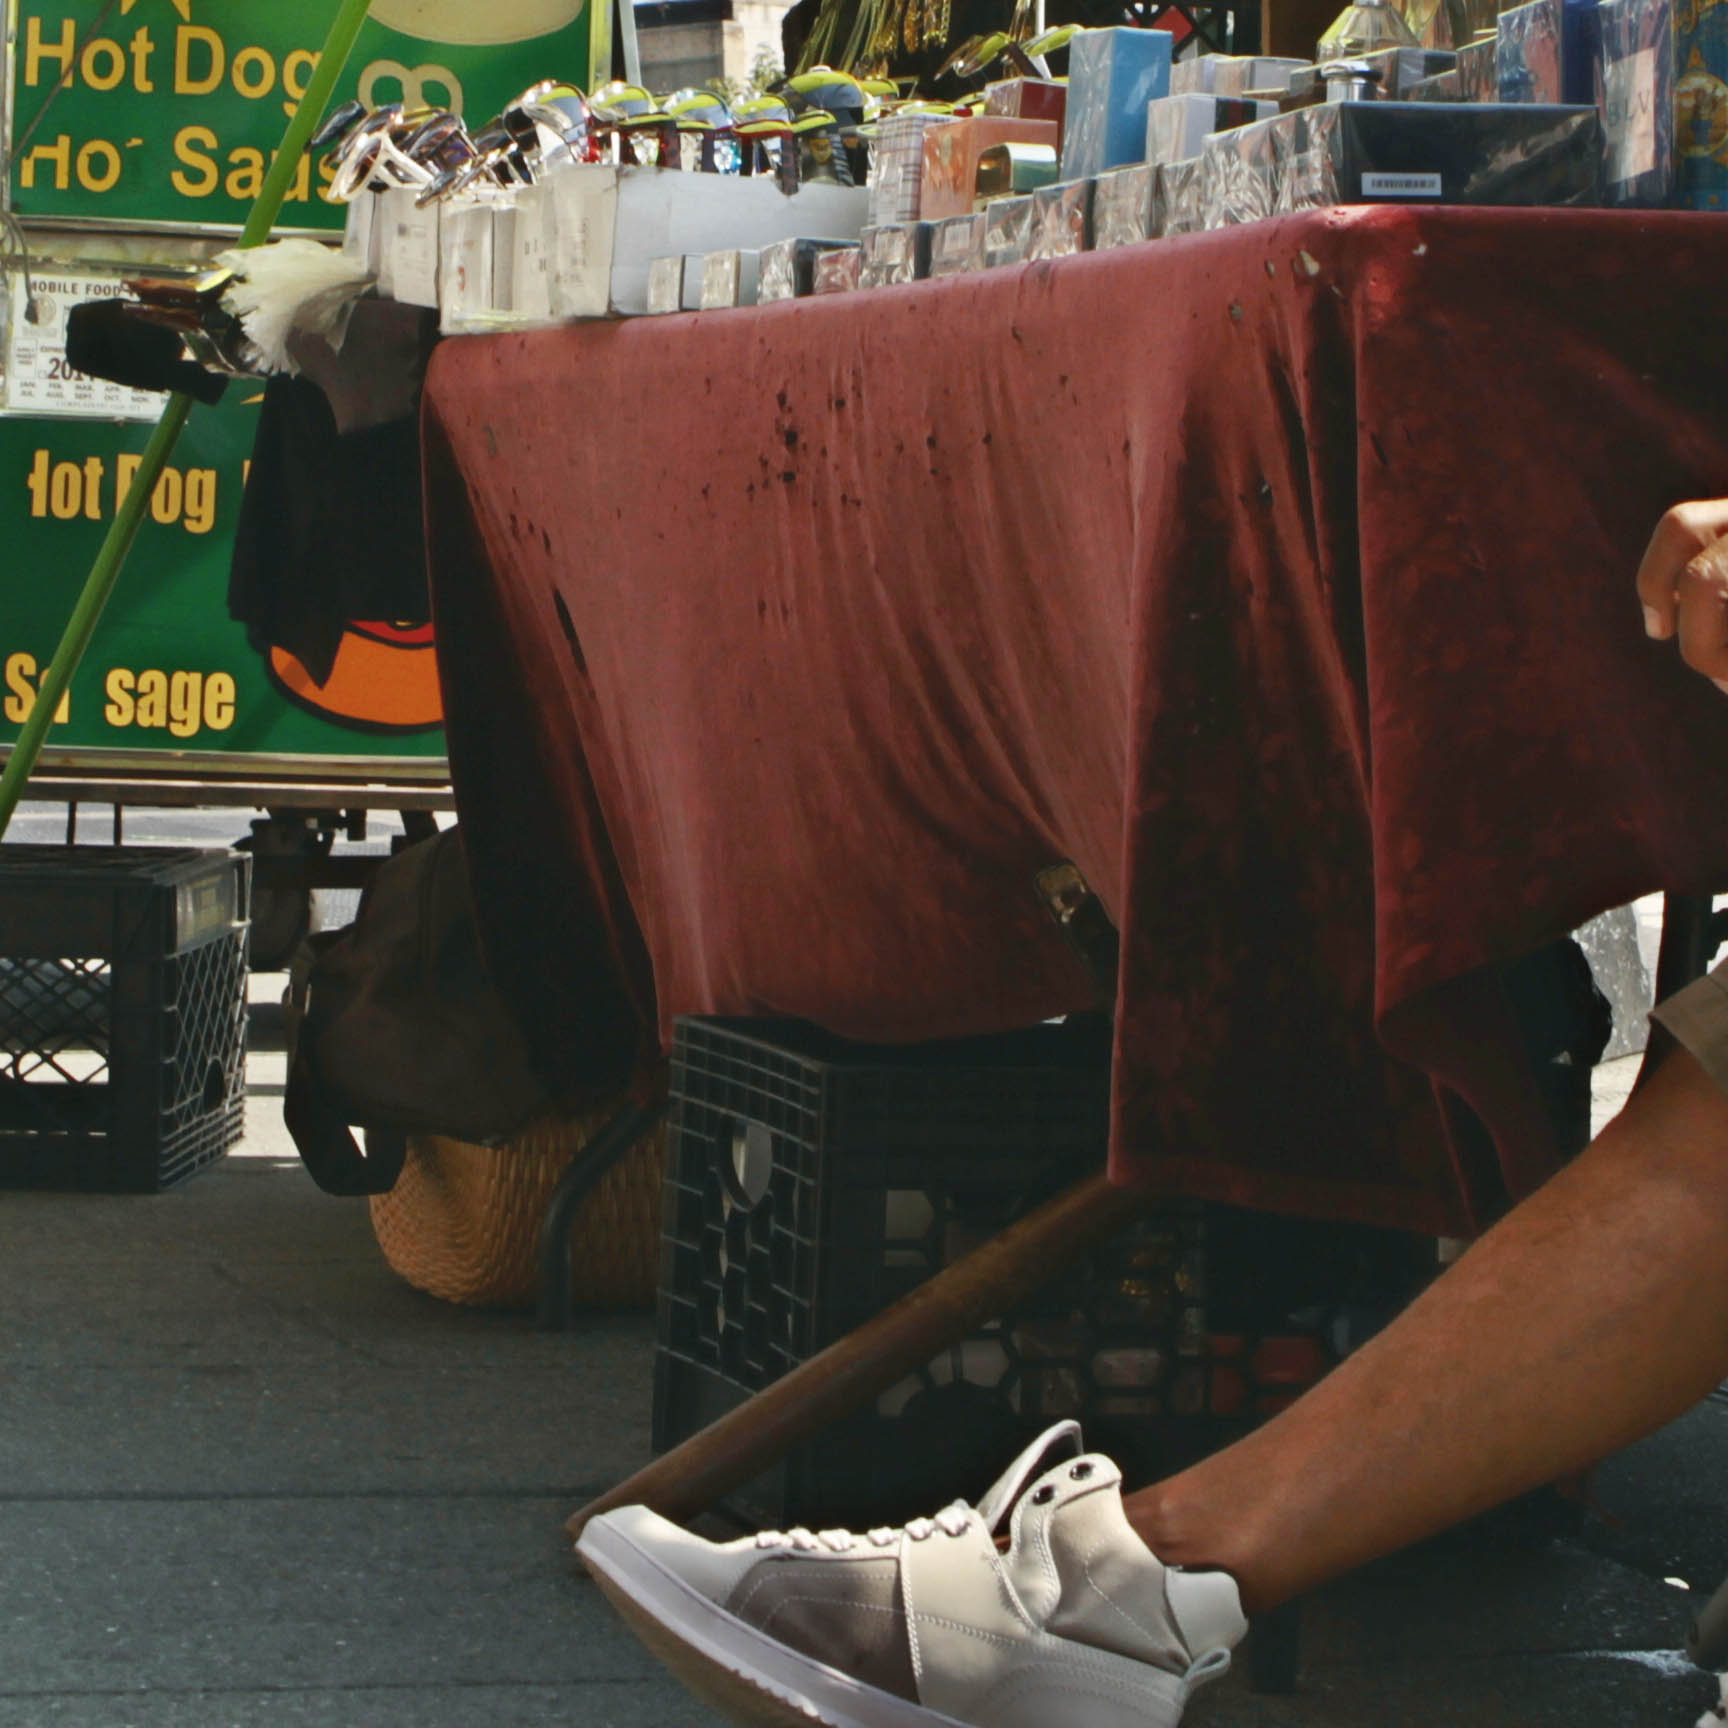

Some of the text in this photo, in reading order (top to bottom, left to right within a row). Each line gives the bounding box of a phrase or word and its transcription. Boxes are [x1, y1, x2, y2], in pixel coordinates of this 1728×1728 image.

[25, 16, 323, 119] Hot Dog
[20, 134, 144, 193] Ho
[85, 283, 121, 297] FOOD
[47, 357, 95, 381] 20
